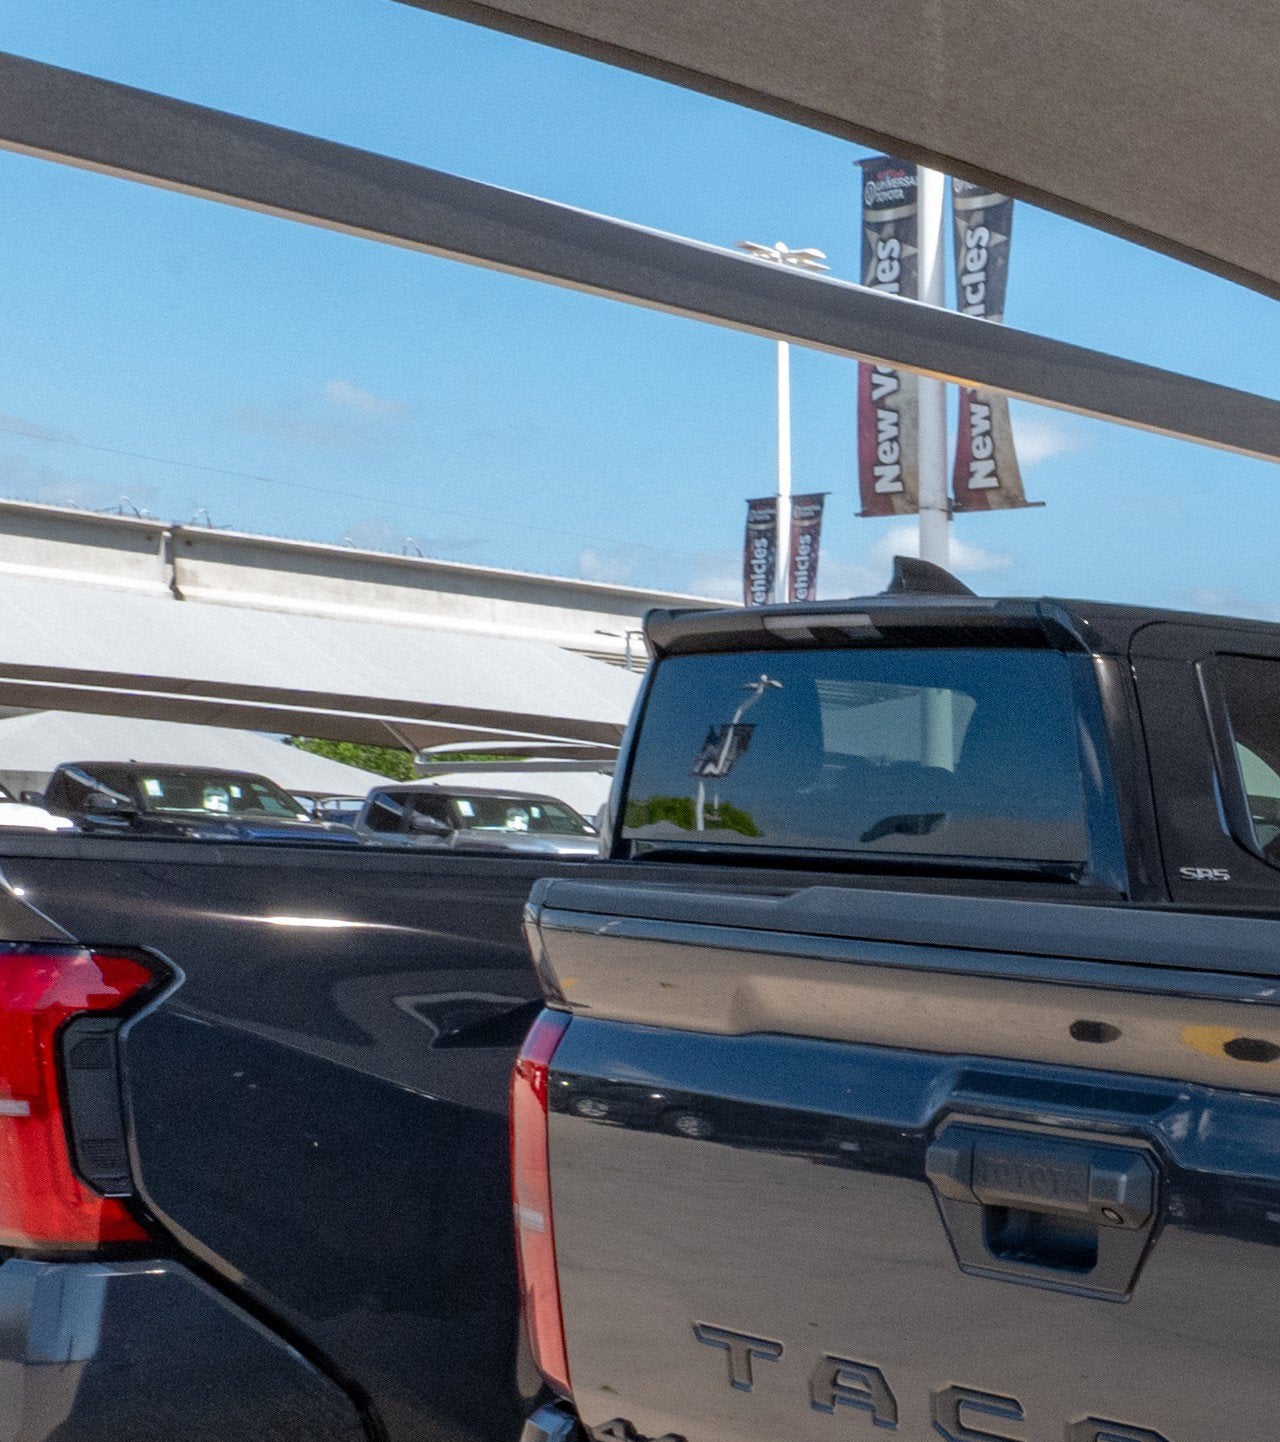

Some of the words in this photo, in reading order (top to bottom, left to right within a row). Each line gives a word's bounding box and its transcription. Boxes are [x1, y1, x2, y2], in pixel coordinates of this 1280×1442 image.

[870, 238, 901, 402] Vles
[873, 408, 904, 494] New
[967, 402, 1000, 490] New
[750, 537, 769, 606] ehicles
[794, 534, 812, 602] ehicles
[1179, 866, 1231, 882] SR5
